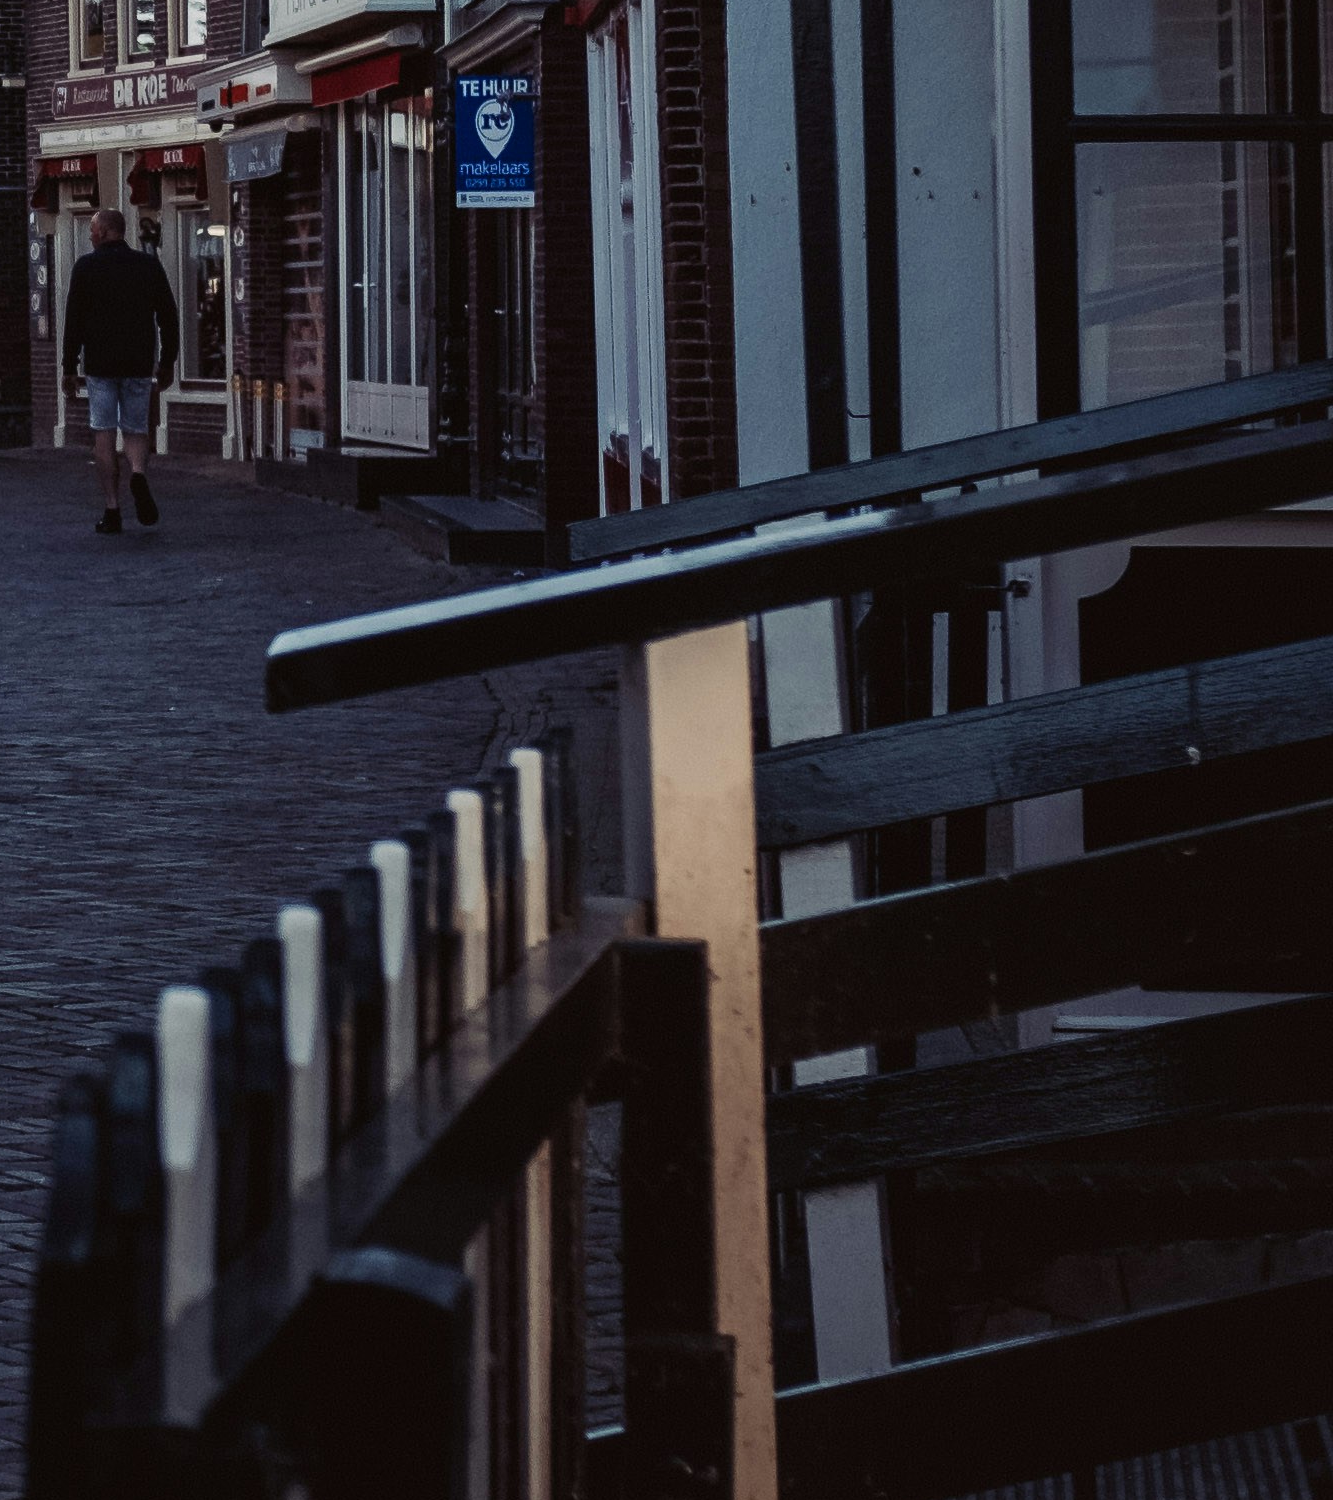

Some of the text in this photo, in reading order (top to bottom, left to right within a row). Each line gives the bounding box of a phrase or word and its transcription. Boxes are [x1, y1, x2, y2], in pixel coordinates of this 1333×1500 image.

[113, 78, 134, 109] DE
[137, 73, 168, 106] KOE
[459, 79, 480, 97] TE
[459, 160, 530, 175] makelaars
